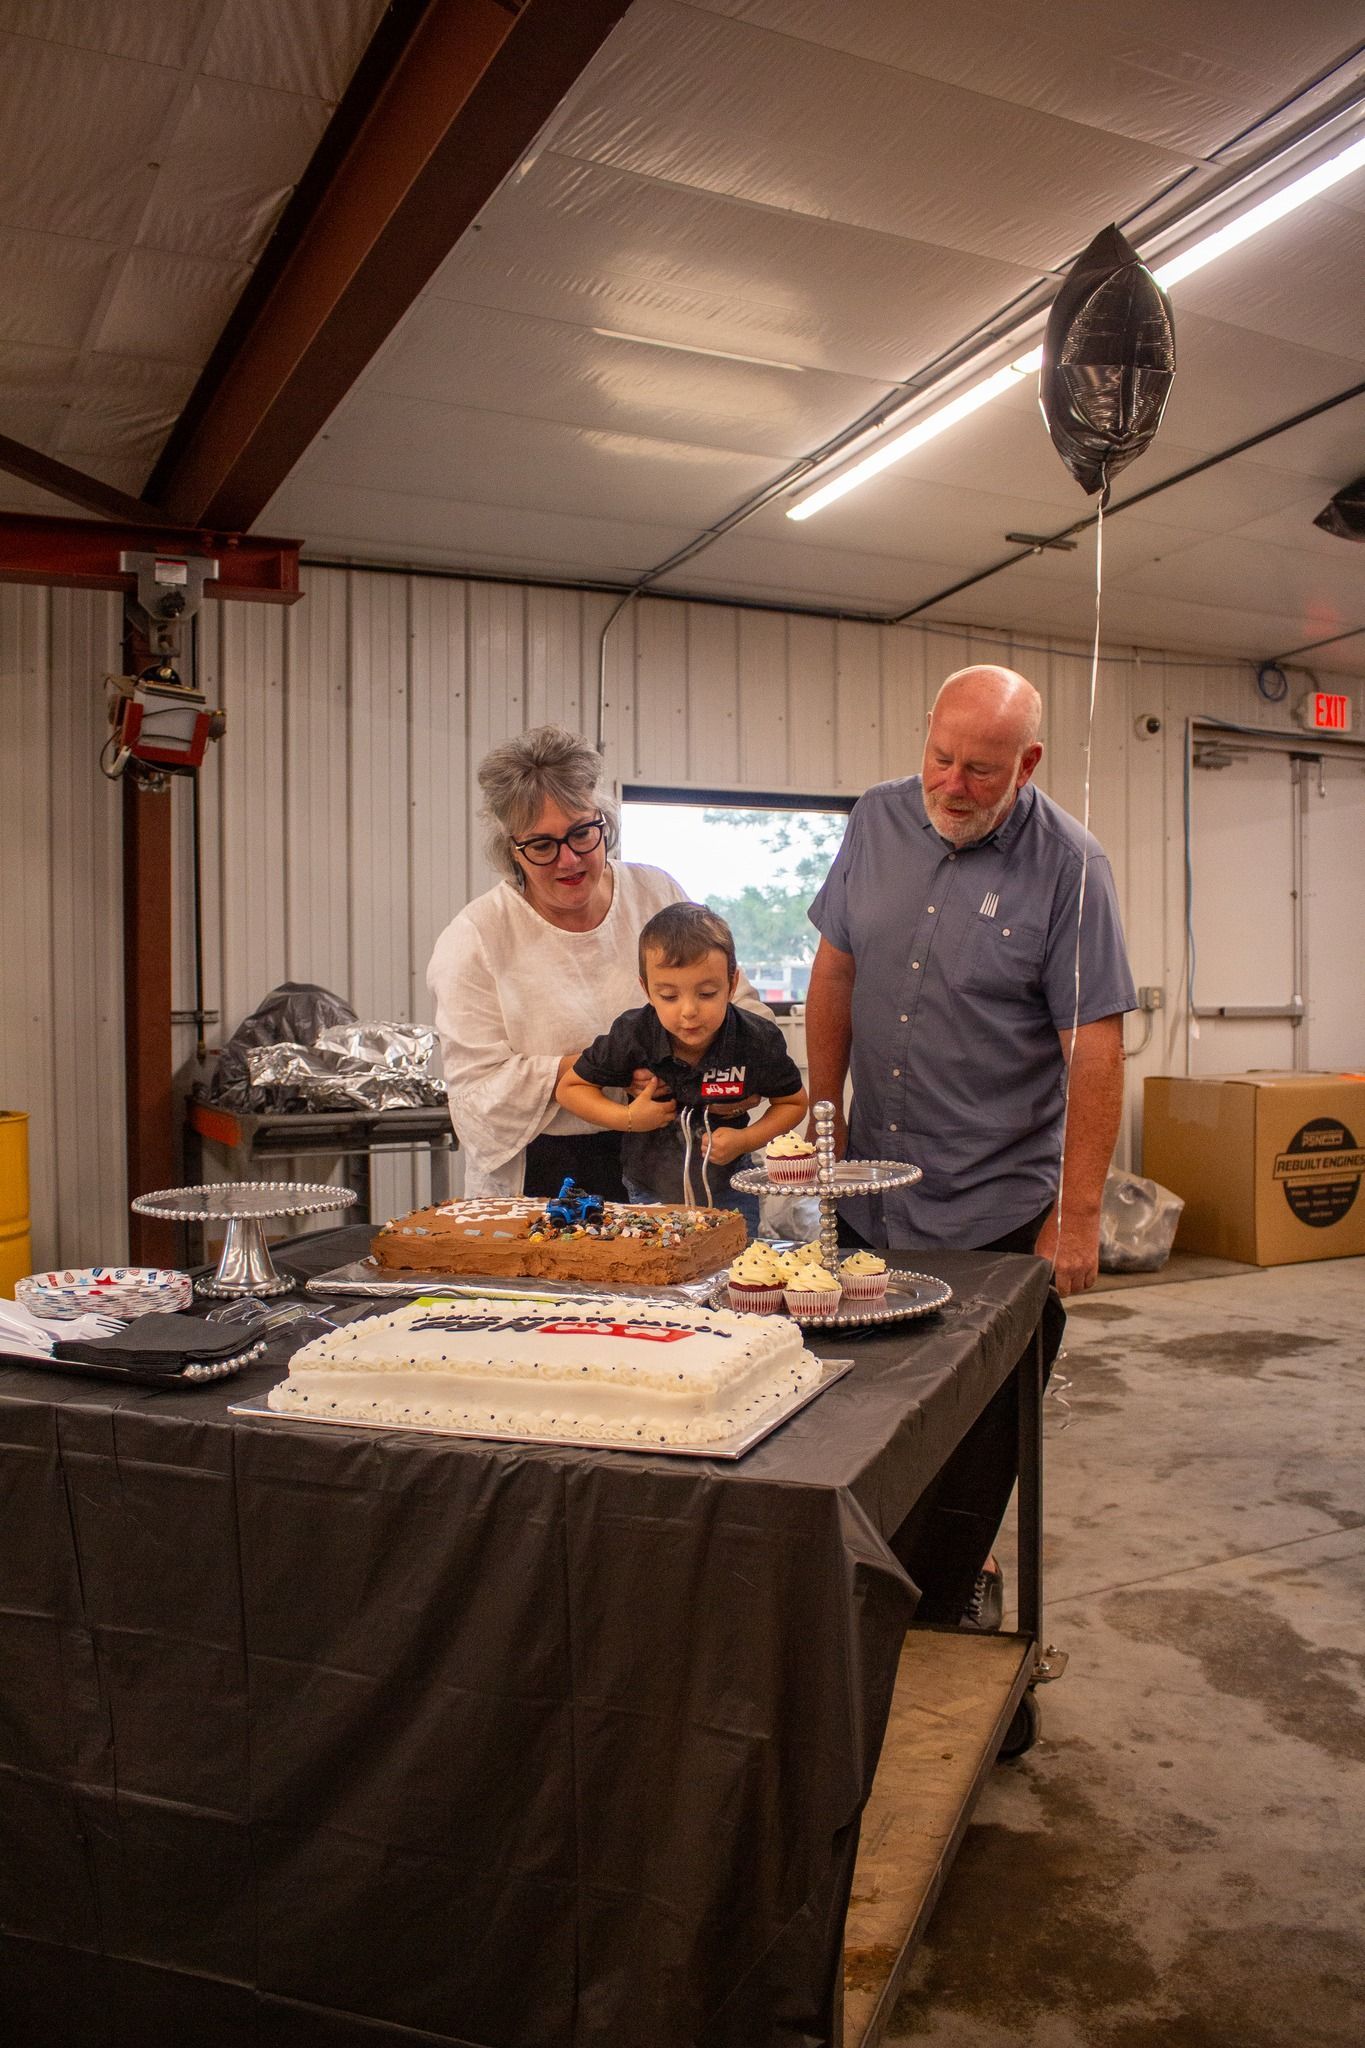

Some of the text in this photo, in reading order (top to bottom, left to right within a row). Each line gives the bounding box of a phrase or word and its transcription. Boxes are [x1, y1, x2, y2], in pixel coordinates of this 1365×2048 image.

[1315, 693, 1348, 729] EXIT
[702, 1066, 746, 1083] PSN
[1277, 1154, 1365, 1172] REBUILT ENGINES
